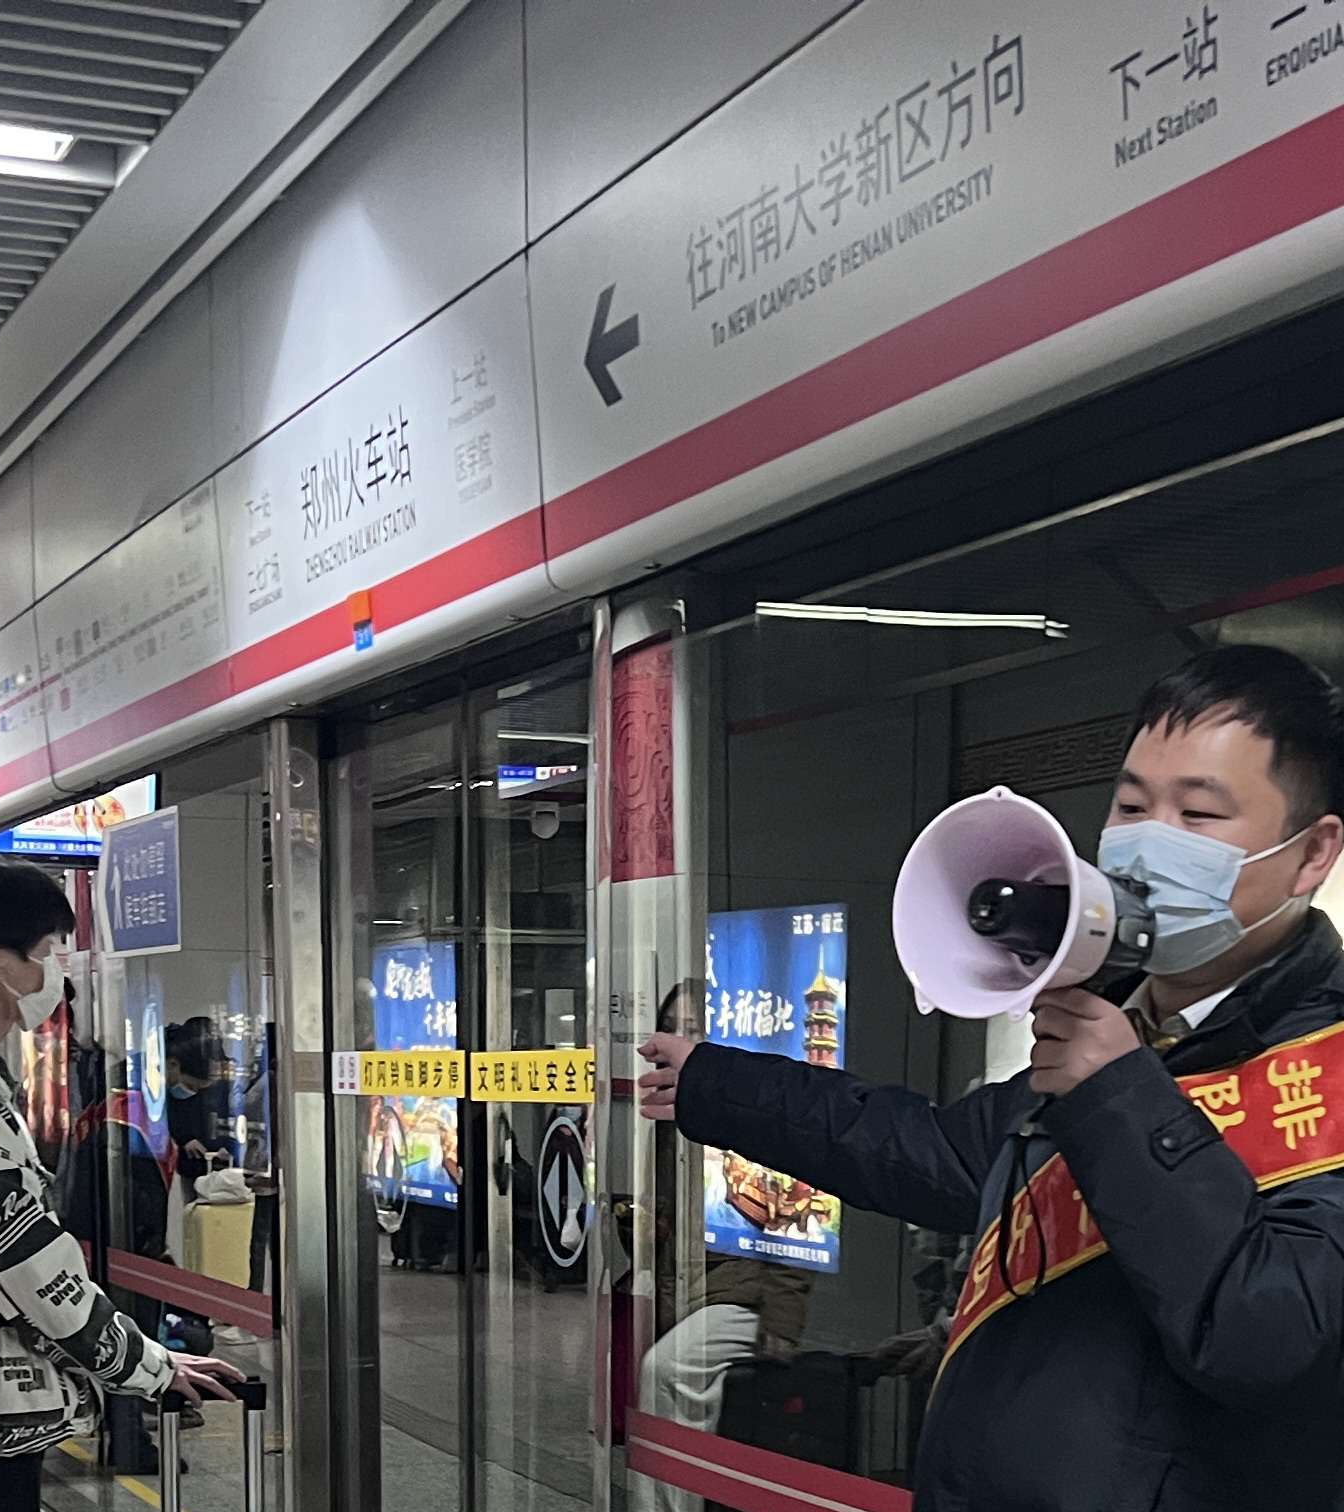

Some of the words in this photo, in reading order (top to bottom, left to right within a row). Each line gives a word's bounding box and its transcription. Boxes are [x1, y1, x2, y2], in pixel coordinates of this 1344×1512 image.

[1110, 5, 1218, 121] 下一站
[685, 34, 1025, 311] 往河南大学新区方向
[1114, 128, 1154, 168] Next
[1156, 97, 1218, 147] Station
[728, 298, 756, 340] NEW
[759, 266, 816, 320] CAMPUS
[818, 253, 837, 288] OF
[840, 221, 894, 277] HENAN
[897, 163, 993, 244] UNIVERSITY
[300, 404, 412, 540] 郑州火车站
[364, 1059, 459, 1089] 灯闪铃响脚步停
